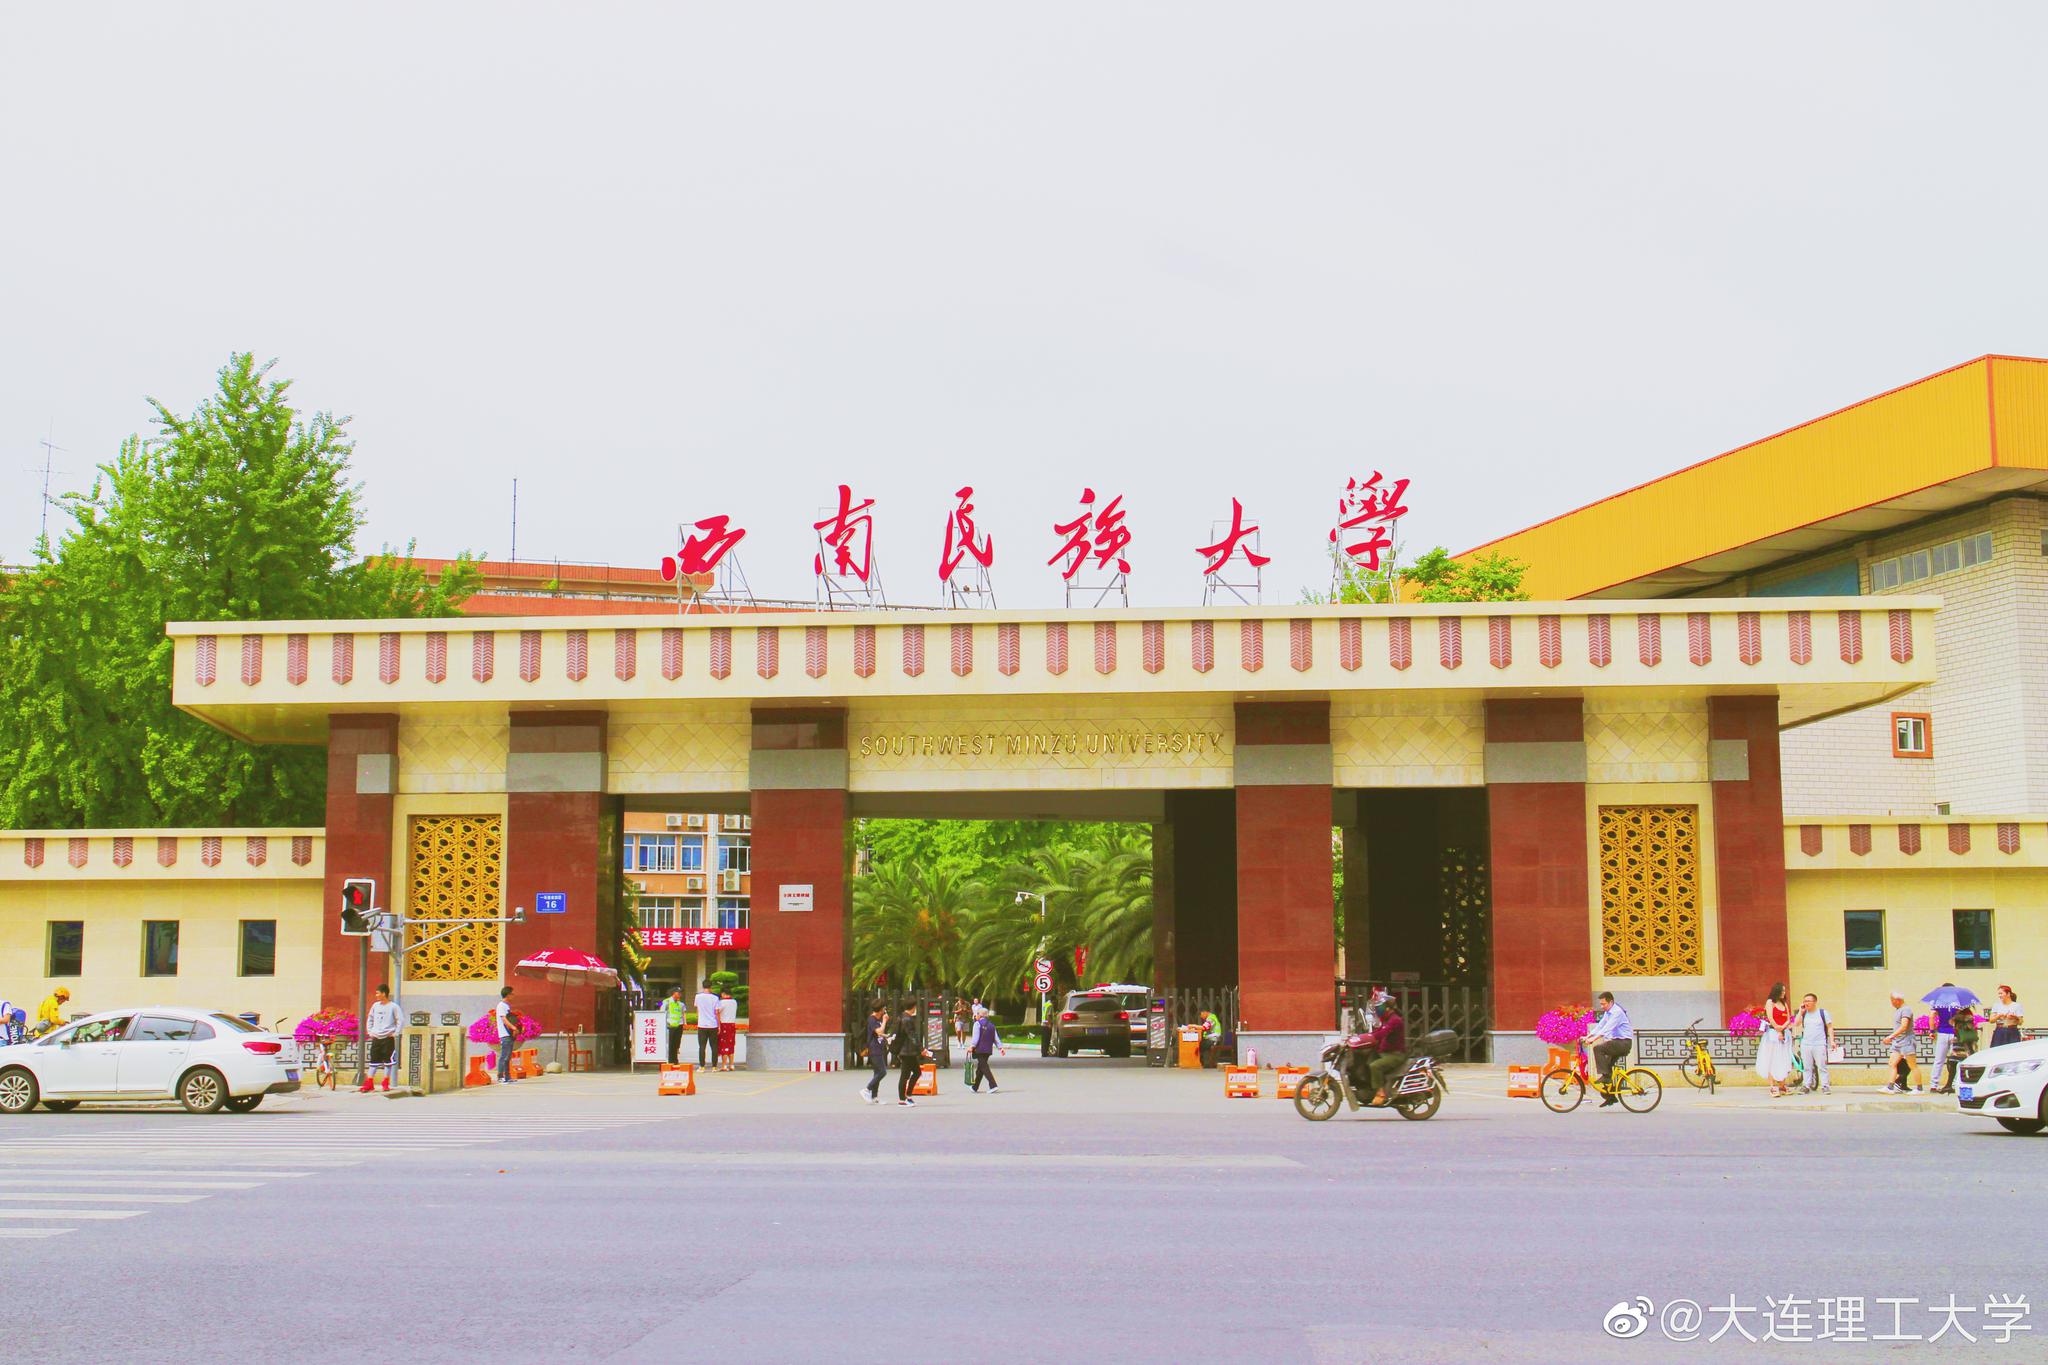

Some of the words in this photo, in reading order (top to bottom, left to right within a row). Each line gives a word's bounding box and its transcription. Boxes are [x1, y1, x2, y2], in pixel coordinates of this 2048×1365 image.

[860, 734, 997, 757] SOUTHWEST
[1006, 734, 1077, 755] MINZU
[1085, 732, 1223, 754] UNIVERSITY
[545, 900, 557, 909] 16
[1039, 977, 1048, 990] 5
[643, 1018, 657, 1055] 凭证进校
